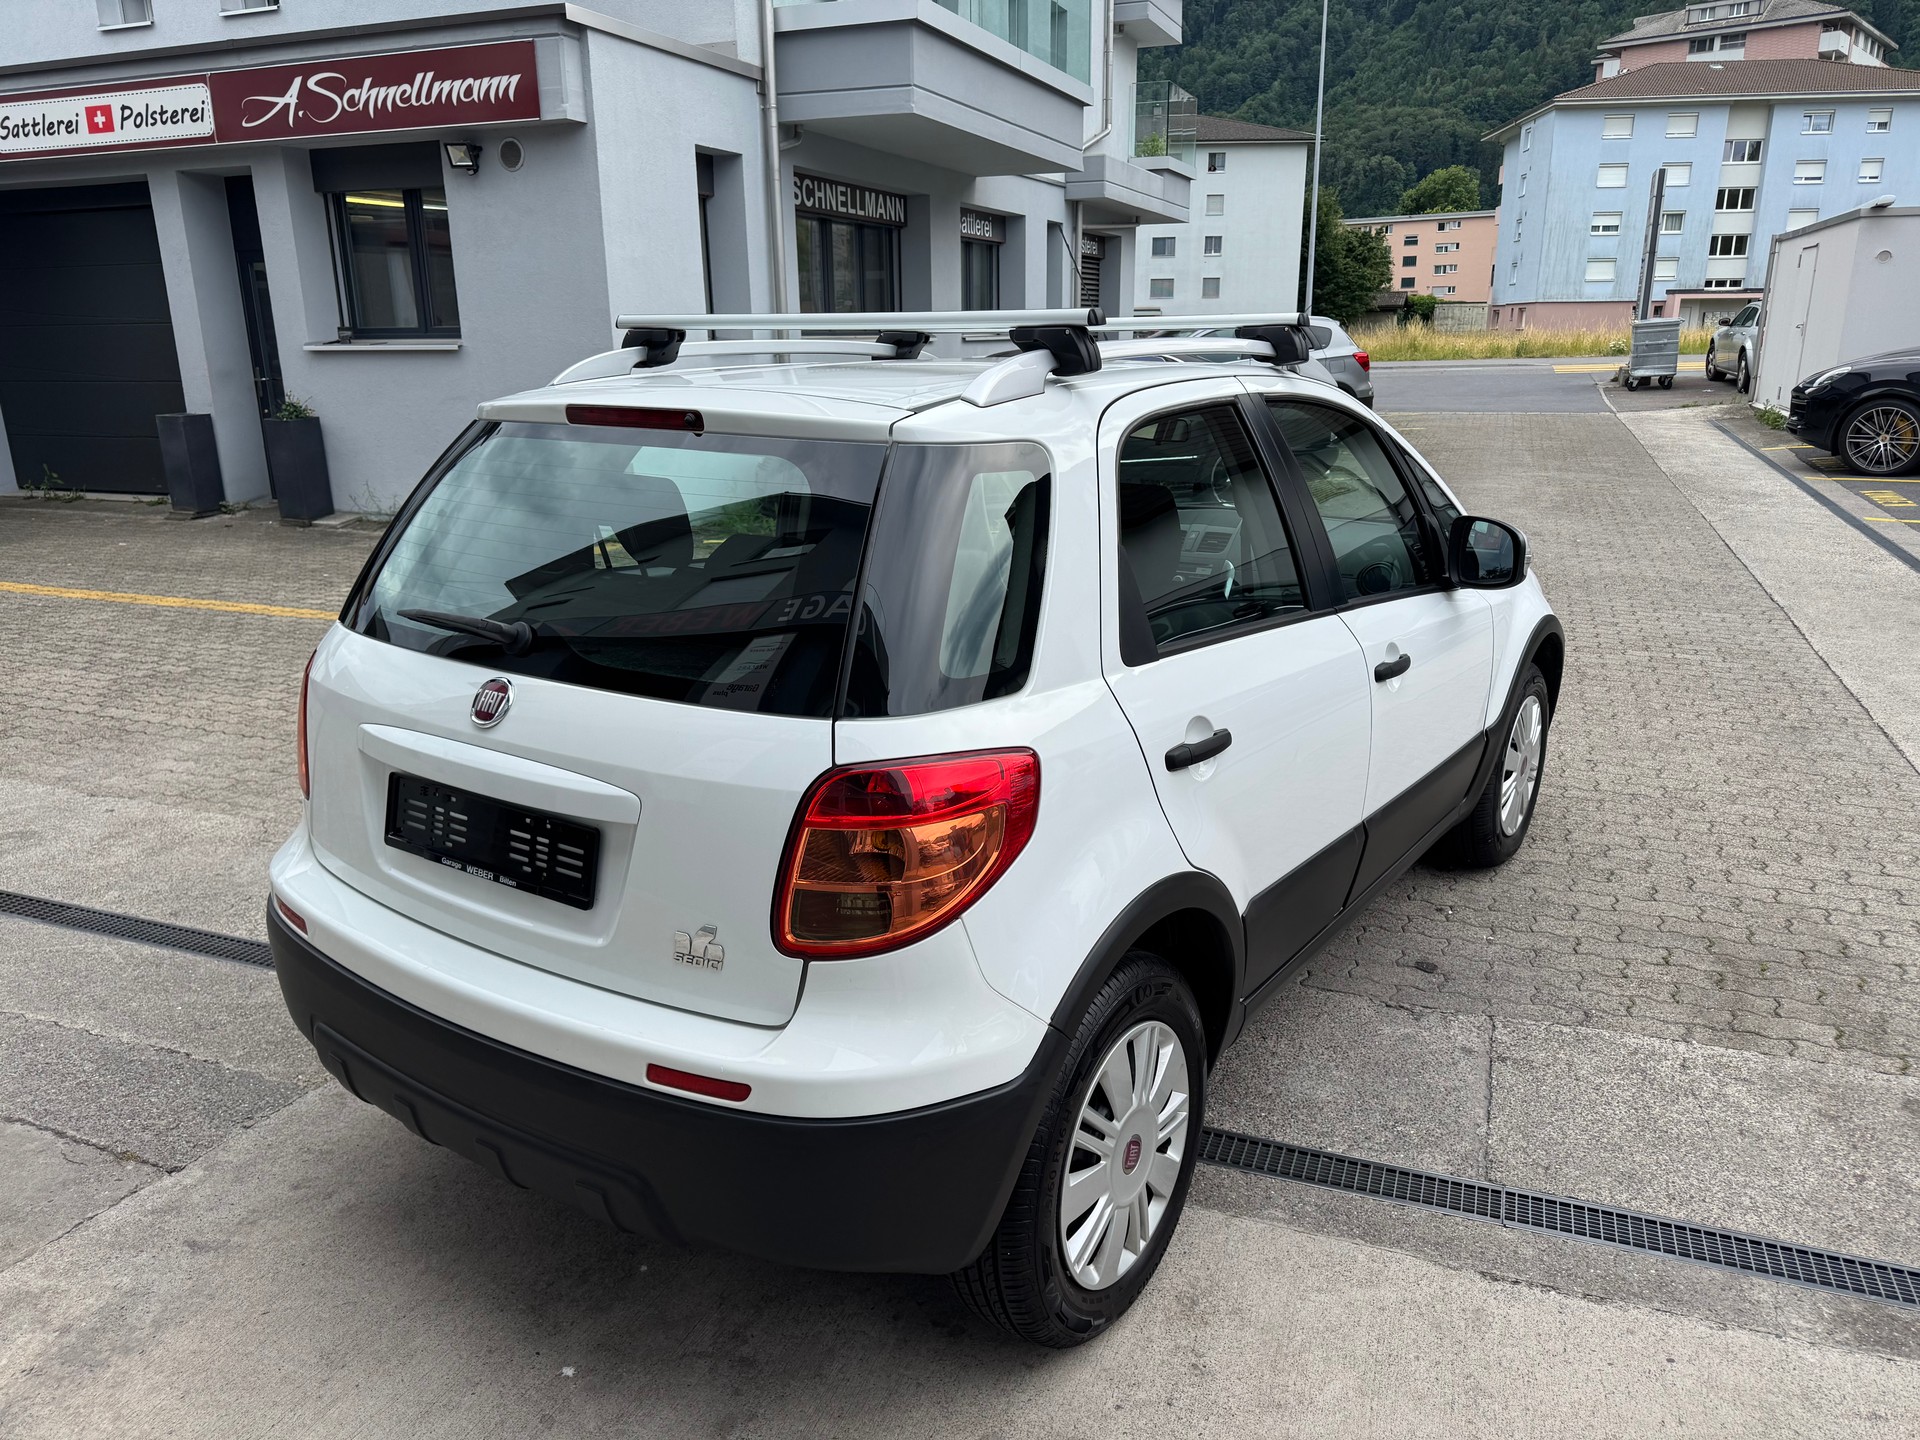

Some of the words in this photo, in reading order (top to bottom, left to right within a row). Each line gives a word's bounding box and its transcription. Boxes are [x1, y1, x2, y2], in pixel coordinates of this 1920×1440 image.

[306, 71, 522, 123] Schnellmann
[0, 112, 79, 140] Sattlerei
[120, 100, 206, 130] Polsterei
[793, 176, 905, 223] SCHNELLMANN
[960, 213, 993, 238] attlerei
[1081, 236, 1099, 255] sterei
[477, 690, 506, 714] FIAT
[441, 857, 462, 869] Garage
[466, 864, 494, 880] WEBER
[673, 951, 724, 971] SEDICI
[1127, 1143, 1140, 1166] FIAT
